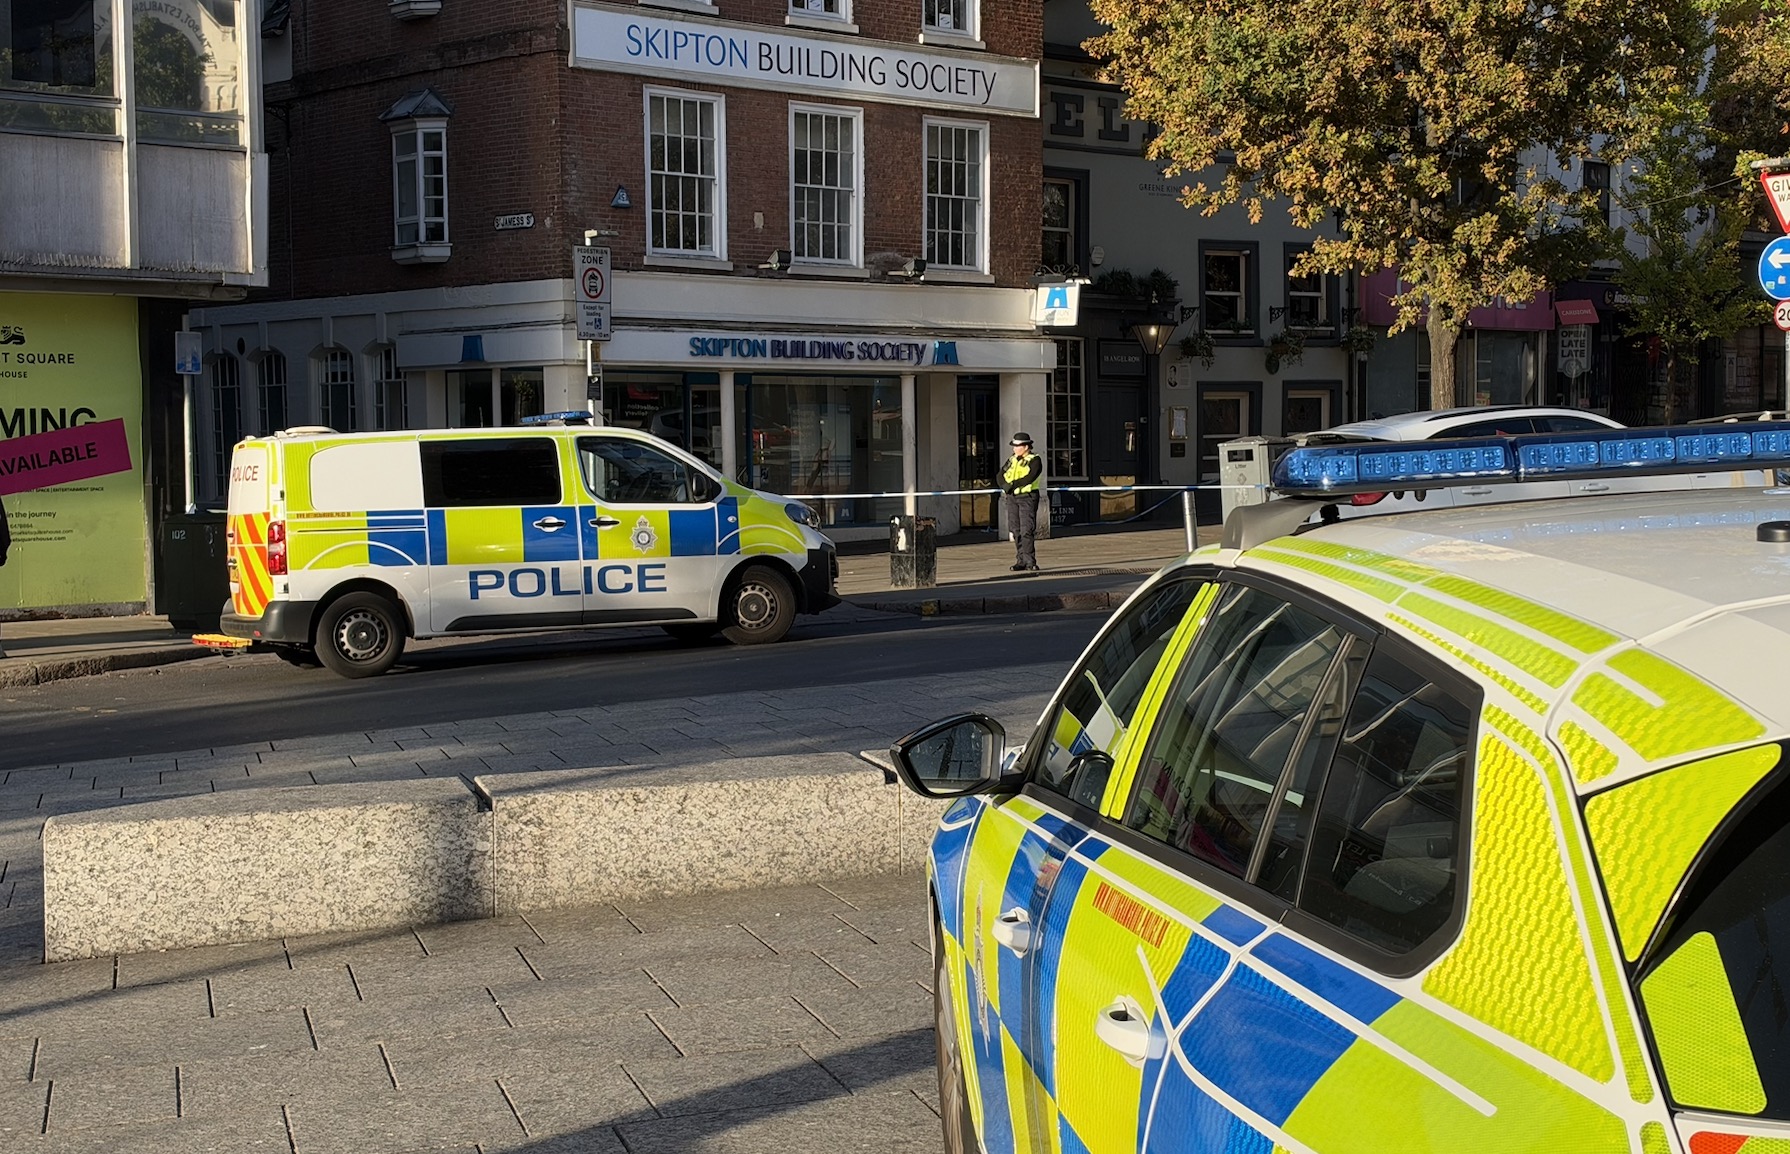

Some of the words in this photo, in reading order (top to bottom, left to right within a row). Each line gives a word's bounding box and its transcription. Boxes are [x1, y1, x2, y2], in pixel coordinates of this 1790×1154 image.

[625, 23, 749, 70] SKIPTON
[757, 42, 887, 86] BUILDING
[895, 59, 997, 105] SOCIETY
[1138, 183, 1165, 193] GREENE
[1166, 185, 1181, 193] KIN
[581, 255, 604, 265] ZONE
[1561, 330, 1586, 338] OPEN
[1561, 340, 1586, 348] LATE
[689, 337, 767, 358] SKIPTON
[770, 339, 855, 361] BUILDING
[857, 341, 927, 366] SOCIETY
[1561, 349, 1586, 358] LATE
[16, 353, 75, 364] SQUARE
[232, 465, 259, 482] POLICE
[28, 511, 57, 519] journey
[171, 530, 186, 540] 102
[469, 563, 667, 600] POLICE
